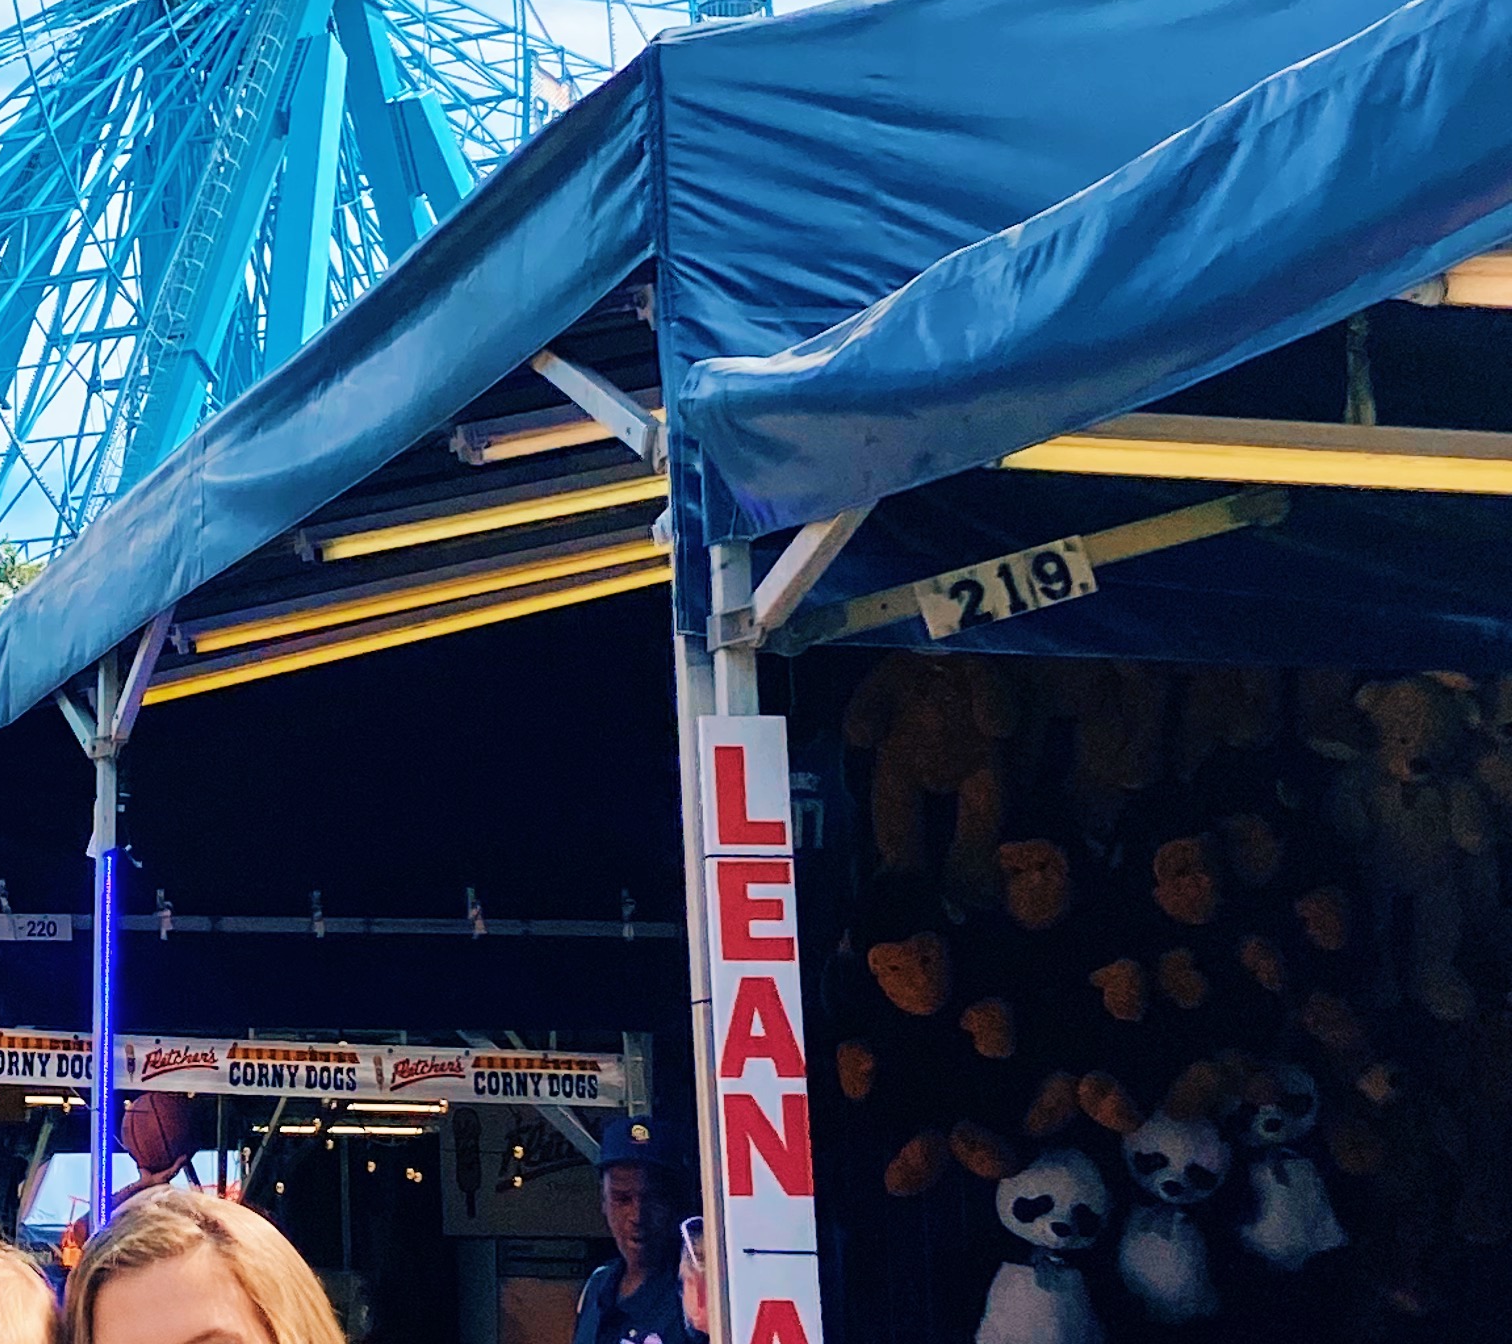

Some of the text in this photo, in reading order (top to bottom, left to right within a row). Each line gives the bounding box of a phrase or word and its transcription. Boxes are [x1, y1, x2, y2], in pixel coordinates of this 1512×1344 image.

[950, 551, 1074, 631] 219
[713, 744, 814, 1197] LEAN
[56, 1053, 92, 1079] DOG
[142, 1045, 357, 1091] Fletcher's CORNY DOGS
[391, 1056, 598, 1099] Fletcher's CORNY DOGS
